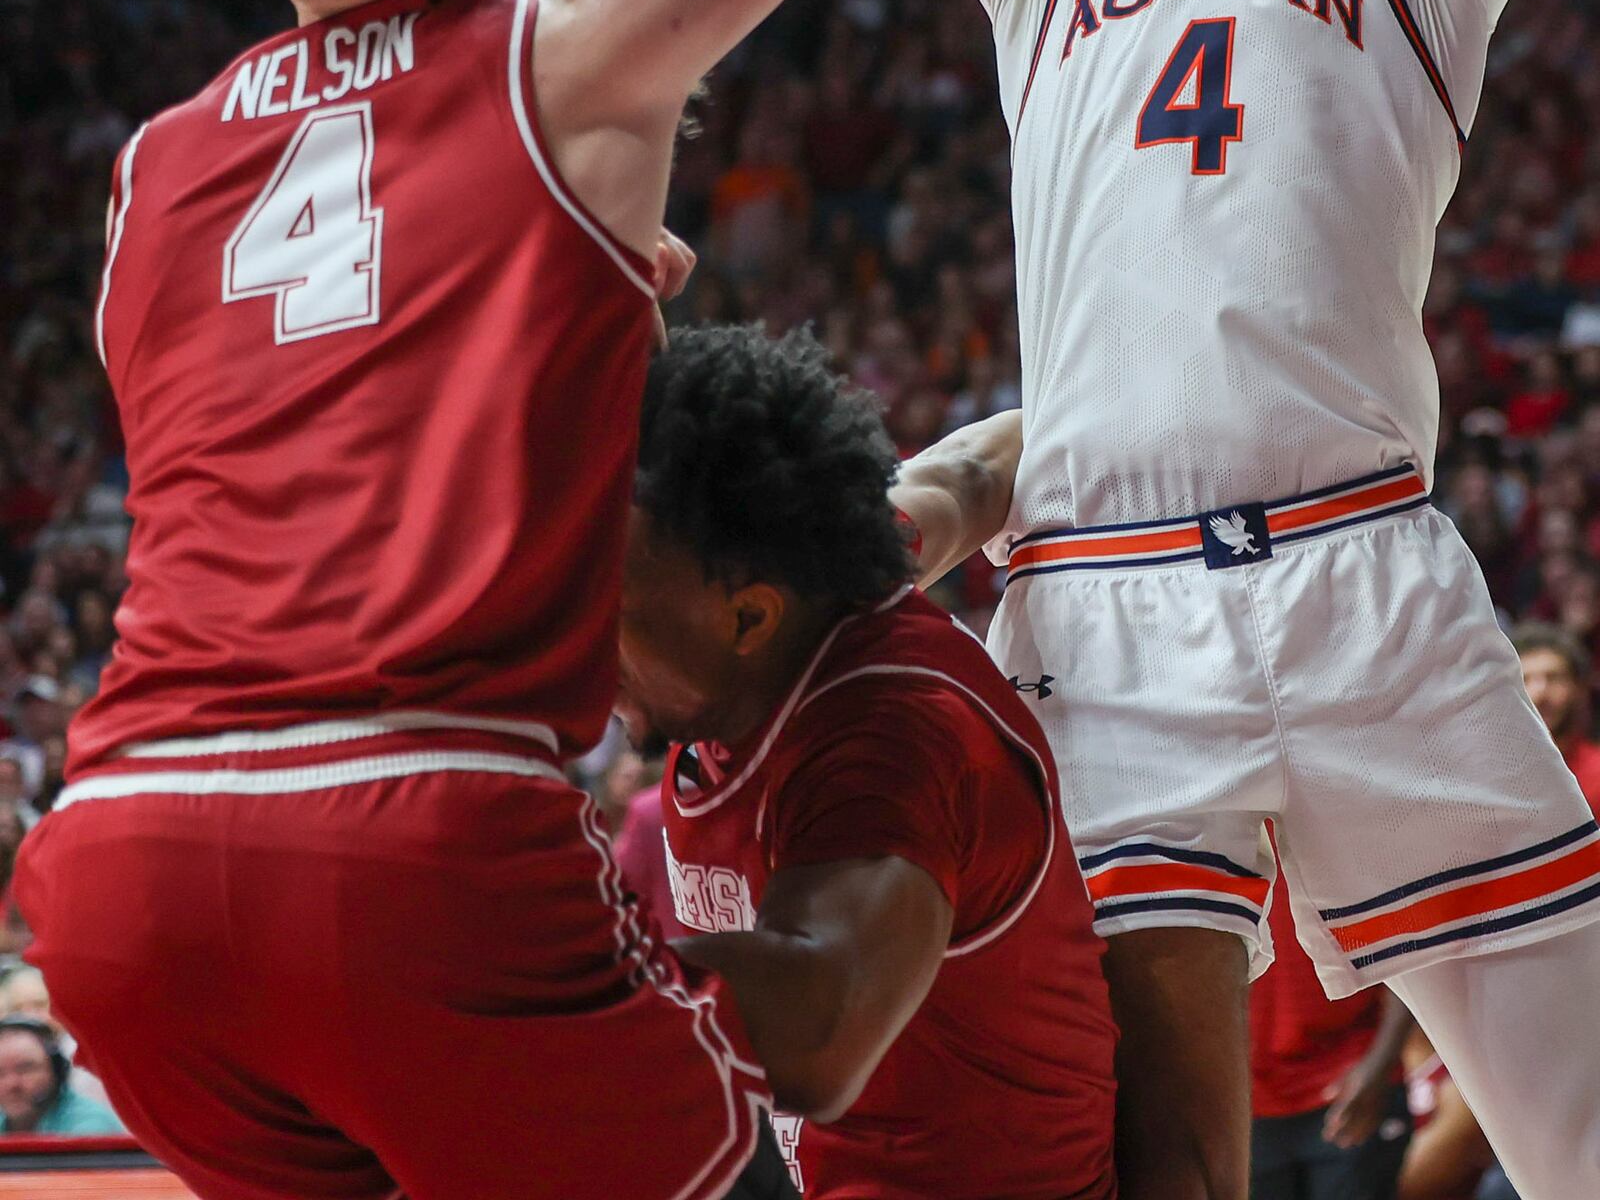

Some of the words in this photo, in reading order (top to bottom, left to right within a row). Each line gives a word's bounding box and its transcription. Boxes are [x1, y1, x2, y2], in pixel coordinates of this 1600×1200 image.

[220, 11, 420, 123] NELSON
[1134, 16, 1245, 175] 4
[221, 99, 384, 346] 4
